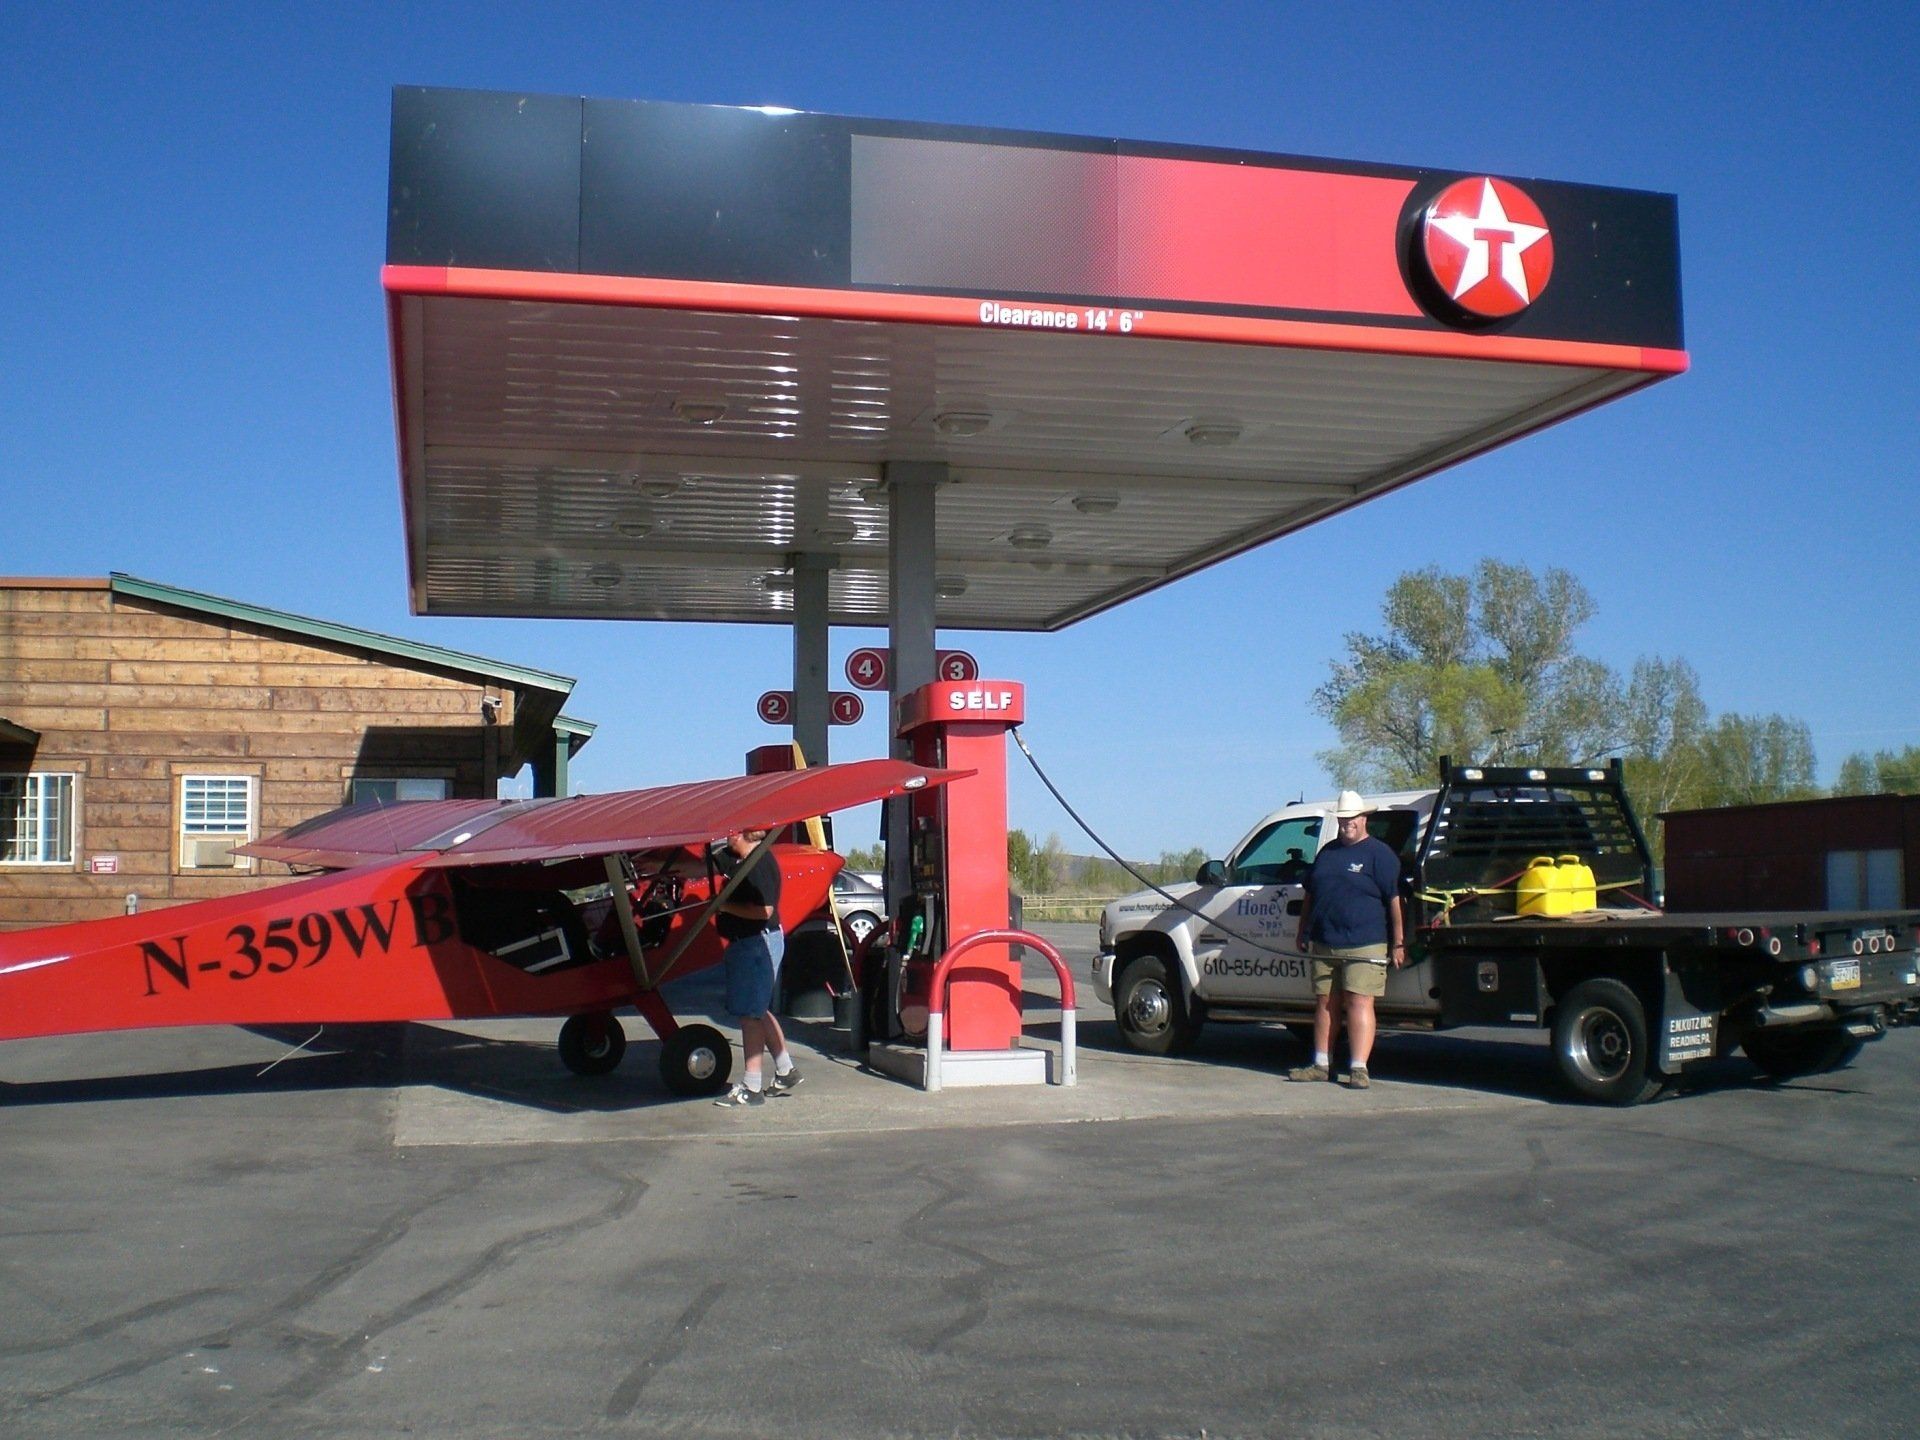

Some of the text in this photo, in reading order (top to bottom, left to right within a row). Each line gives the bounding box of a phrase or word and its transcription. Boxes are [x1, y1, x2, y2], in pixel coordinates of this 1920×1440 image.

[979, 301, 1078, 329] Clearance
[1085, 309, 1114, 330] 14'
[858, 659, 874, 678] 4
[950, 661, 965, 680] 3
[767, 699, 779, 714] 2
[841, 701, 851, 715] 1
[950, 691, 1012, 711] SELF
[1237, 899, 1283, 919] Honey
[1258, 919, 1283, 930] Spas
[135, 893, 454, 997] N-359WB
[1203, 957, 1307, 978] 610-856-6051
